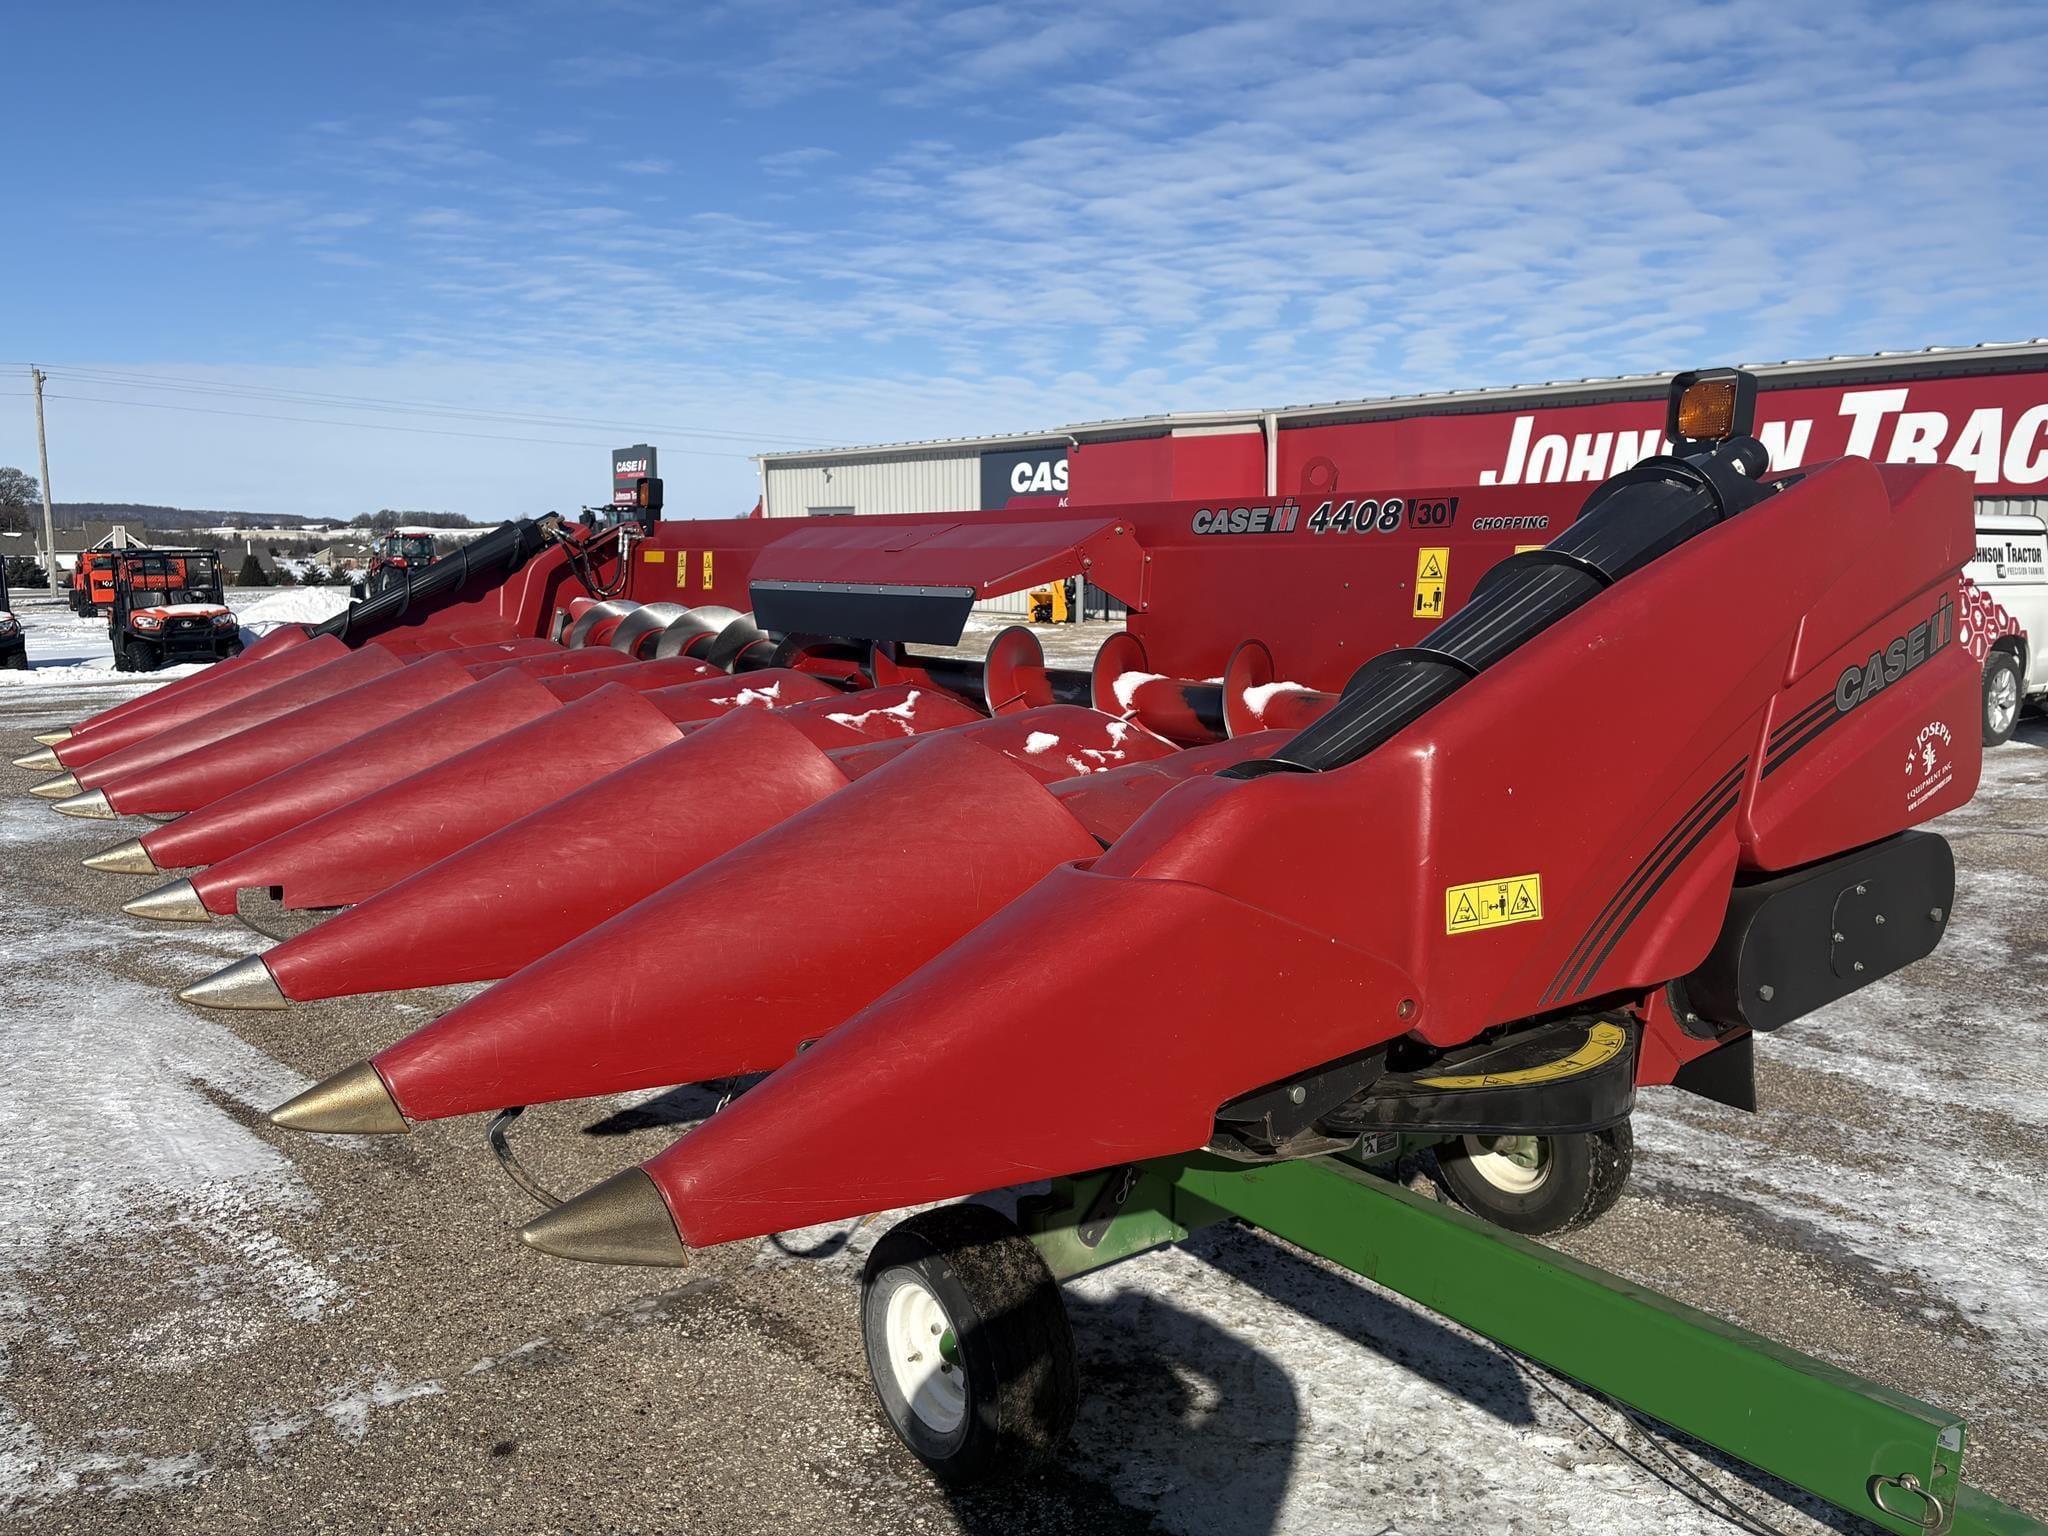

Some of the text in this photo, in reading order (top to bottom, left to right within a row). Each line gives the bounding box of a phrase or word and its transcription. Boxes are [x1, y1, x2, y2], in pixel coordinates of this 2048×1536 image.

[616, 460, 638, 472] CASE
[1479, 416, 1813, 486] JOHNN
[1010, 459, 1069, 493] CAS
[1192, 507, 1271, 535] CASE
[1307, 497, 1404, 536] 4408
[1418, 502, 1447, 525] 30
[1472, 515, 1549, 531] CHOPPING
[2005, 542, 2042, 563] TRACTOR
[1835, 620, 1927, 712] CASE
[1916, 721, 1952, 750] JOSEPH
[1907, 768, 1942, 800] EQUIPMENT
